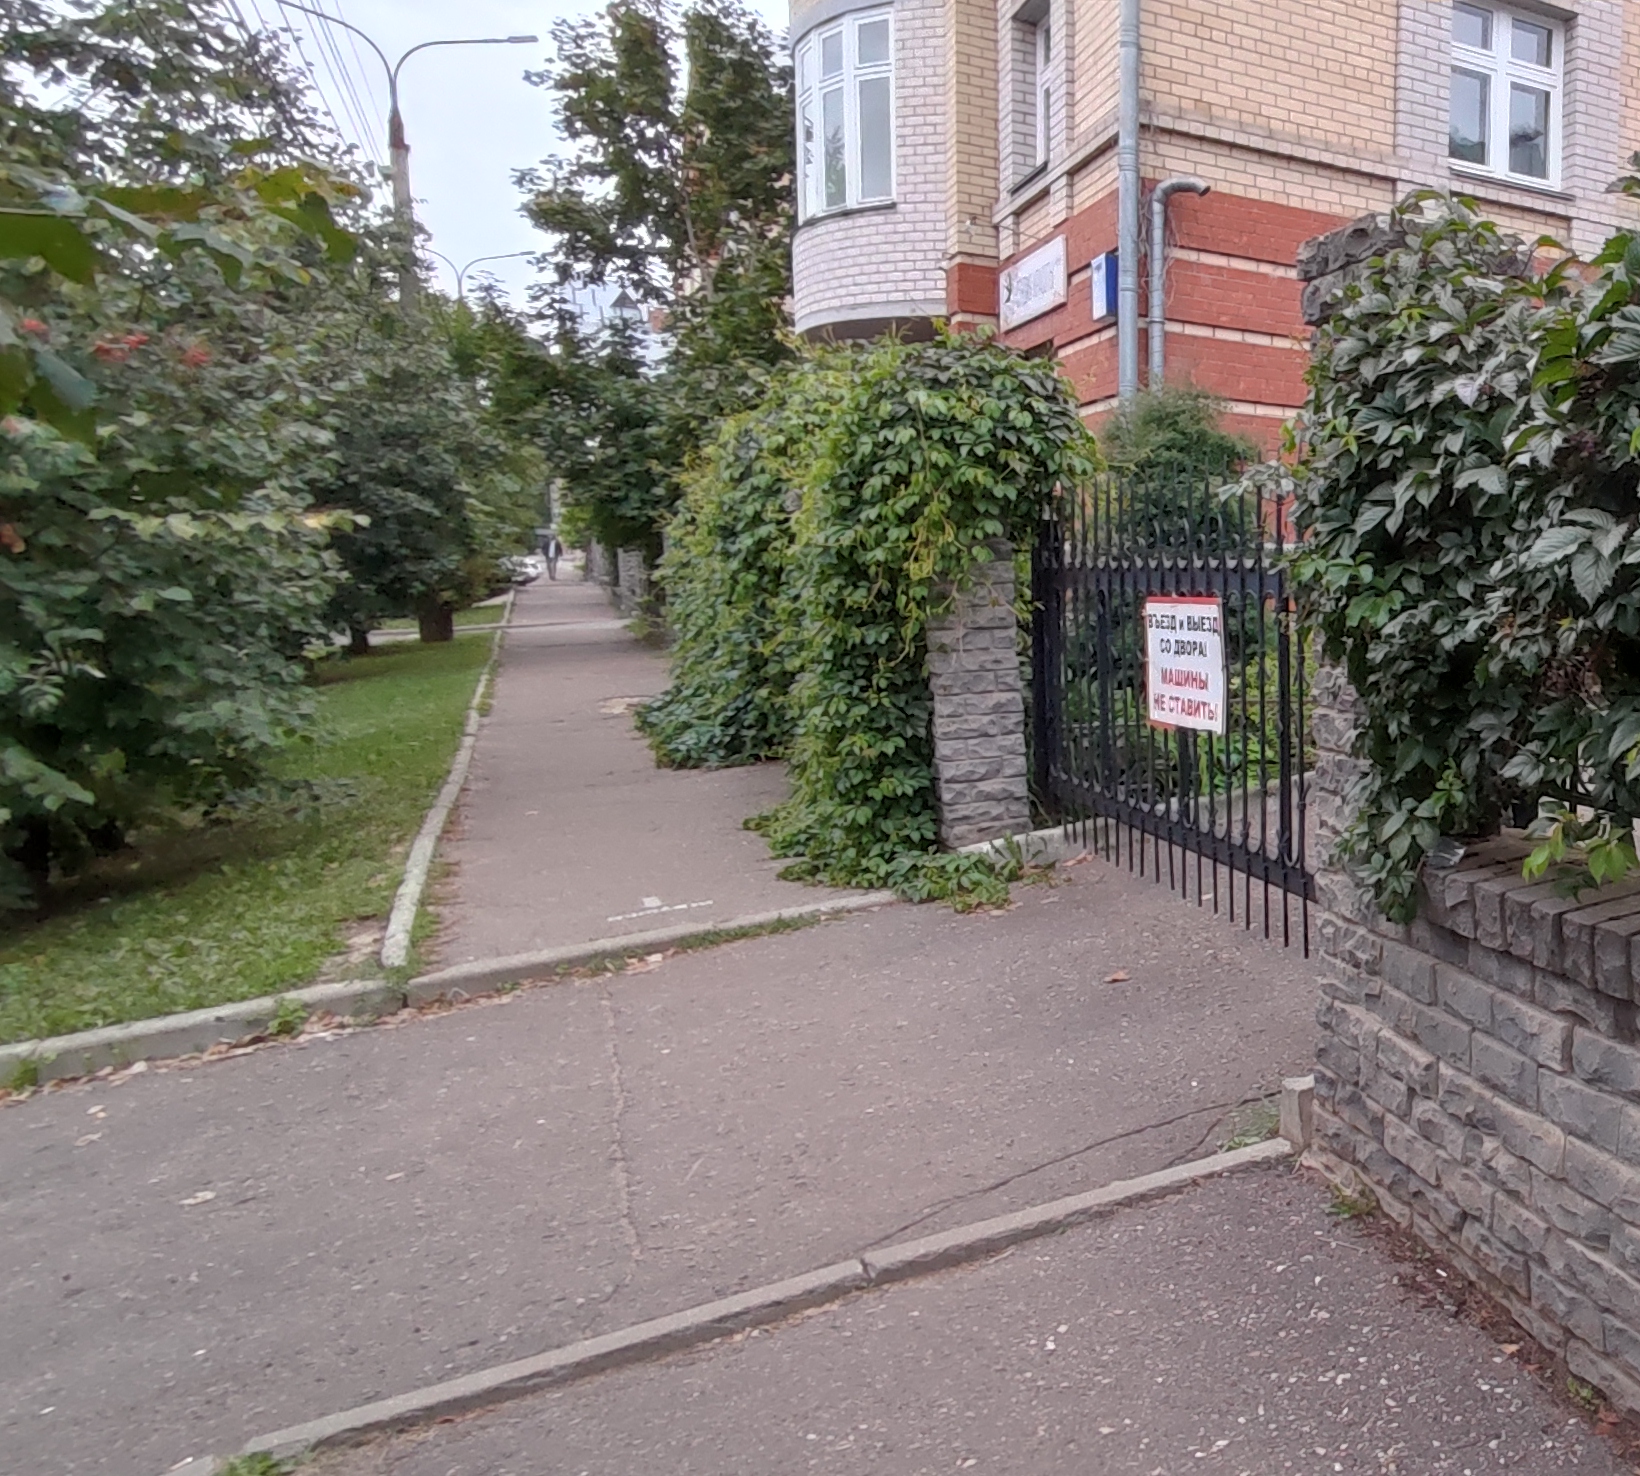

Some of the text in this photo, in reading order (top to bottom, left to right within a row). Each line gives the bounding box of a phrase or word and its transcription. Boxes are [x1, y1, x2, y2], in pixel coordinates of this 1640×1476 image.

[1148, 613, 1176, 634] ВЪЕЗД
[1187, 615, 1220, 637] ВЫЕЗД
[1159, 638, 1172, 654] СО
[1160, 667, 1209, 691] МАШИНЫ
[1153, 693, 1219, 722] НЕ СТАВИТЬ!
